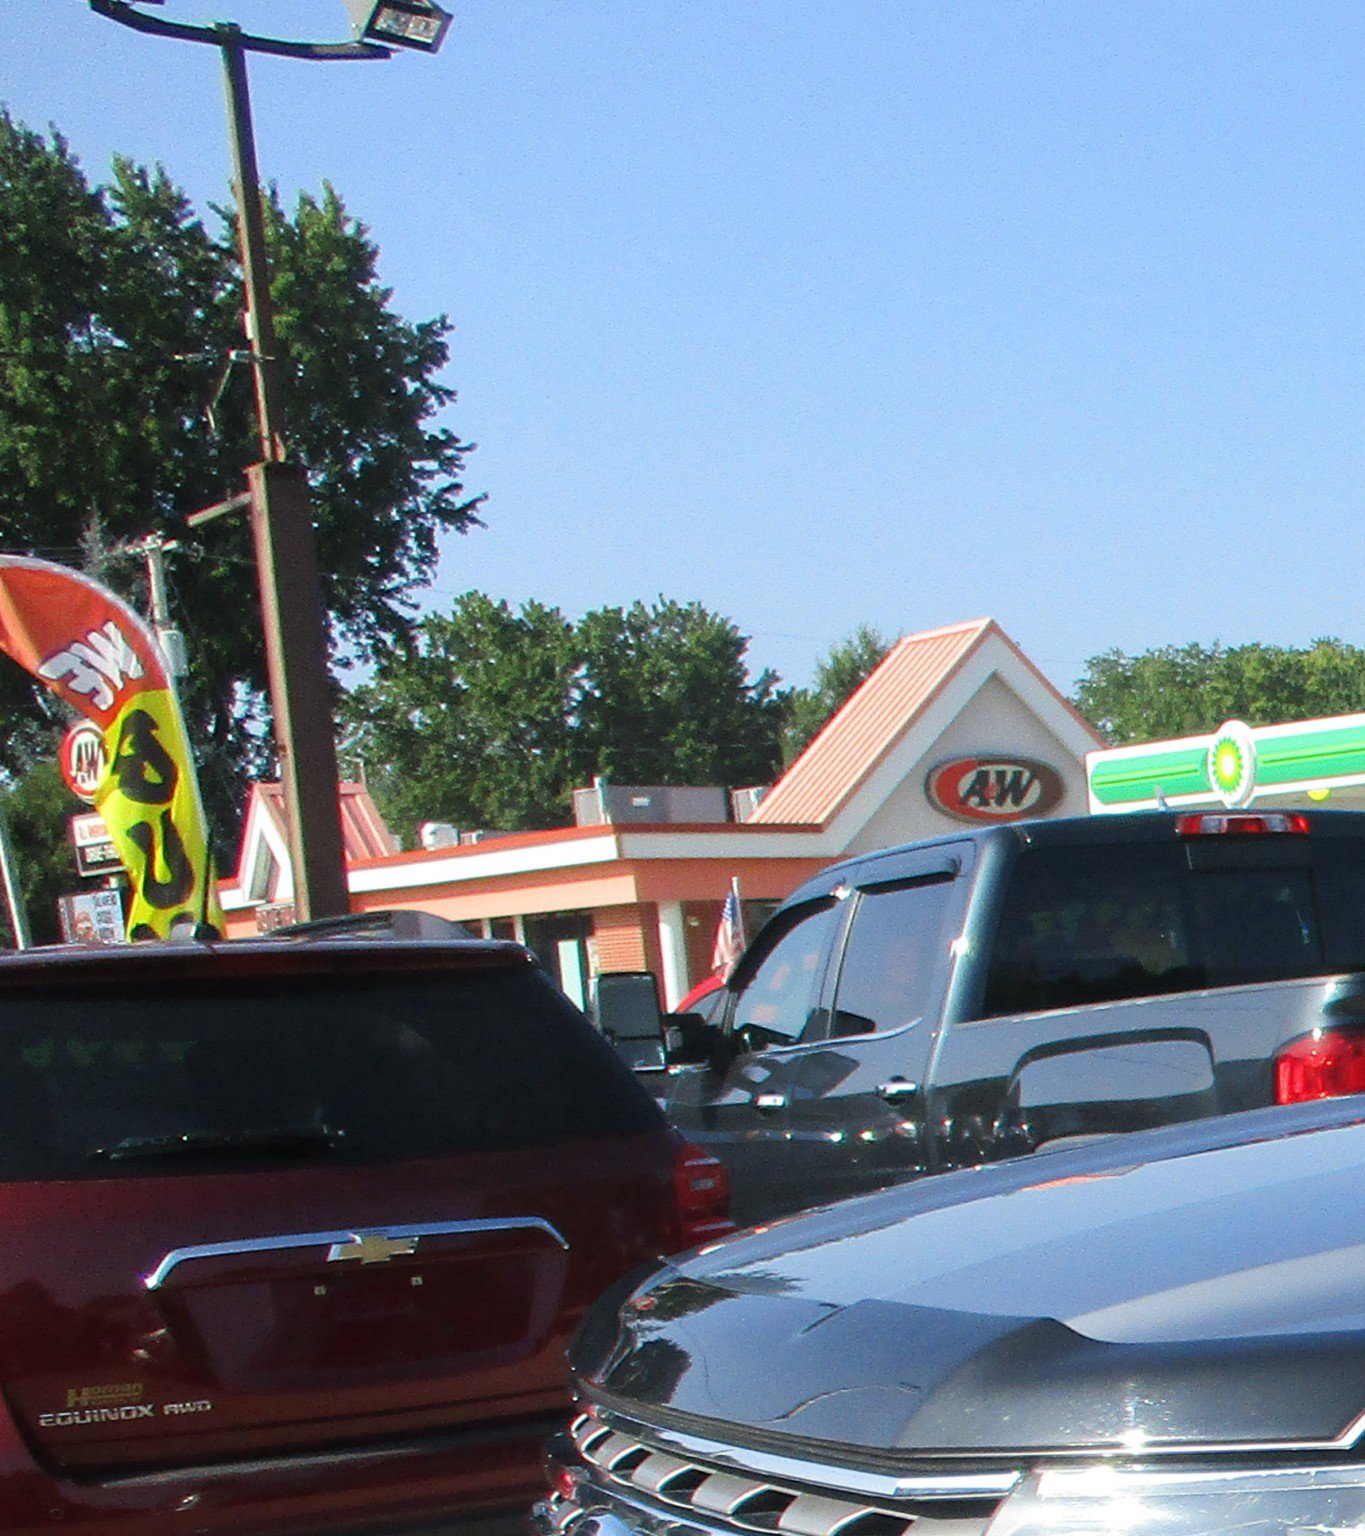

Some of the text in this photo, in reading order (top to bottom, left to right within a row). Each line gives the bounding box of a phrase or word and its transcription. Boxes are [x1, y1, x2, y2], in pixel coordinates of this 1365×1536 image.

[959, 768, 1034, 807] A&W
[38, 1399, 212, 1428] EQUINOX AWD
